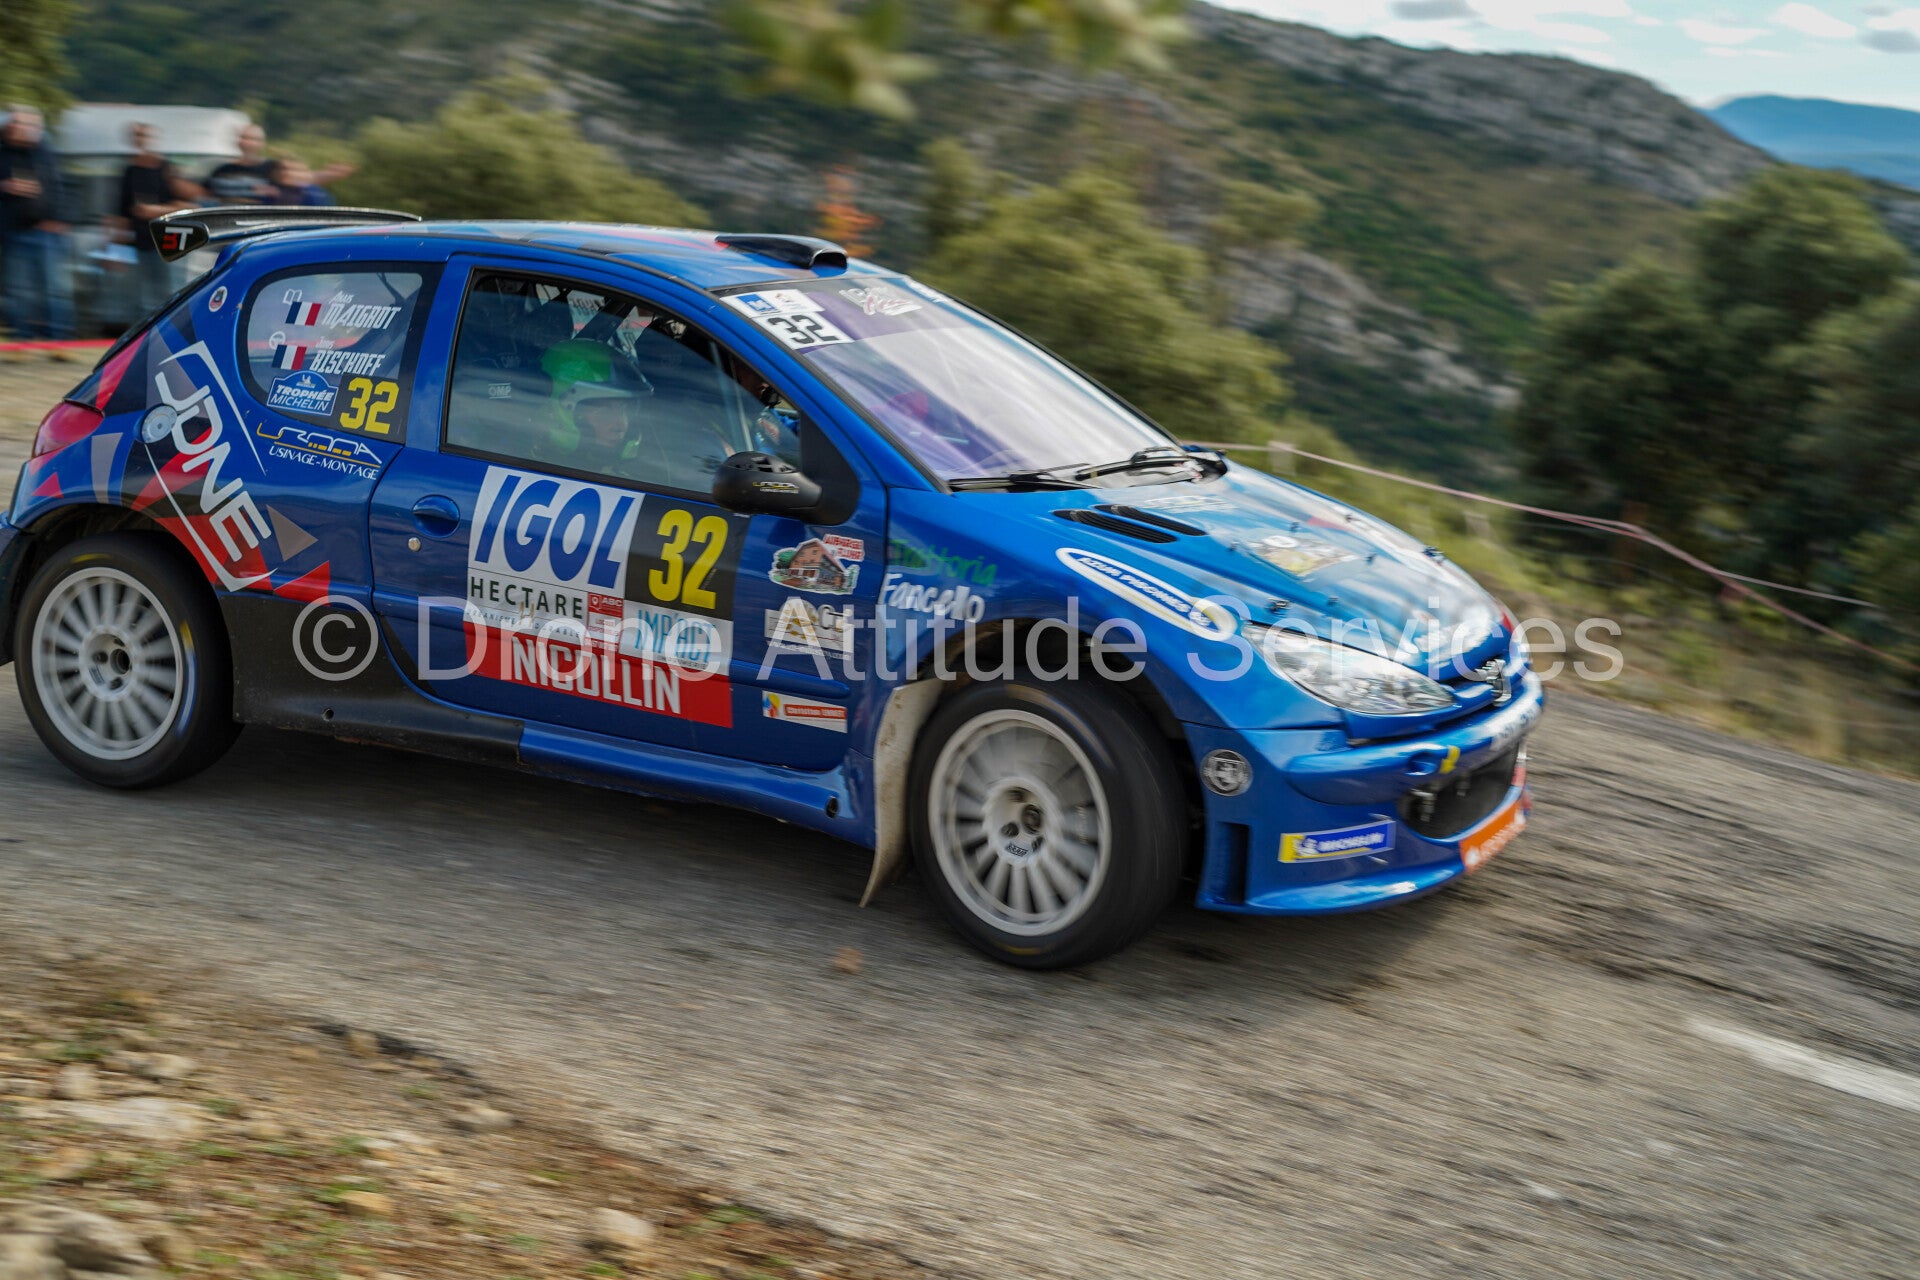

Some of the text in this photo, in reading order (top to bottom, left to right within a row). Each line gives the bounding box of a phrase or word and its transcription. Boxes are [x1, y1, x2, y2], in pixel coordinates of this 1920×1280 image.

[767, 314, 840, 345] 32
[309, 349, 386, 377] BISCHOFF
[270, 394, 330, 412] MICHELIN
[276, 384, 335, 401] TROPHÉE
[339, 377, 400, 435] 32
[474, 474, 636, 590] IGOL
[648, 509, 729, 610] 32
[471, 576, 583, 620] HECTARE
[601, 597, 623, 608] ABC
[512, 636, 681, 714] NICOLLIN
